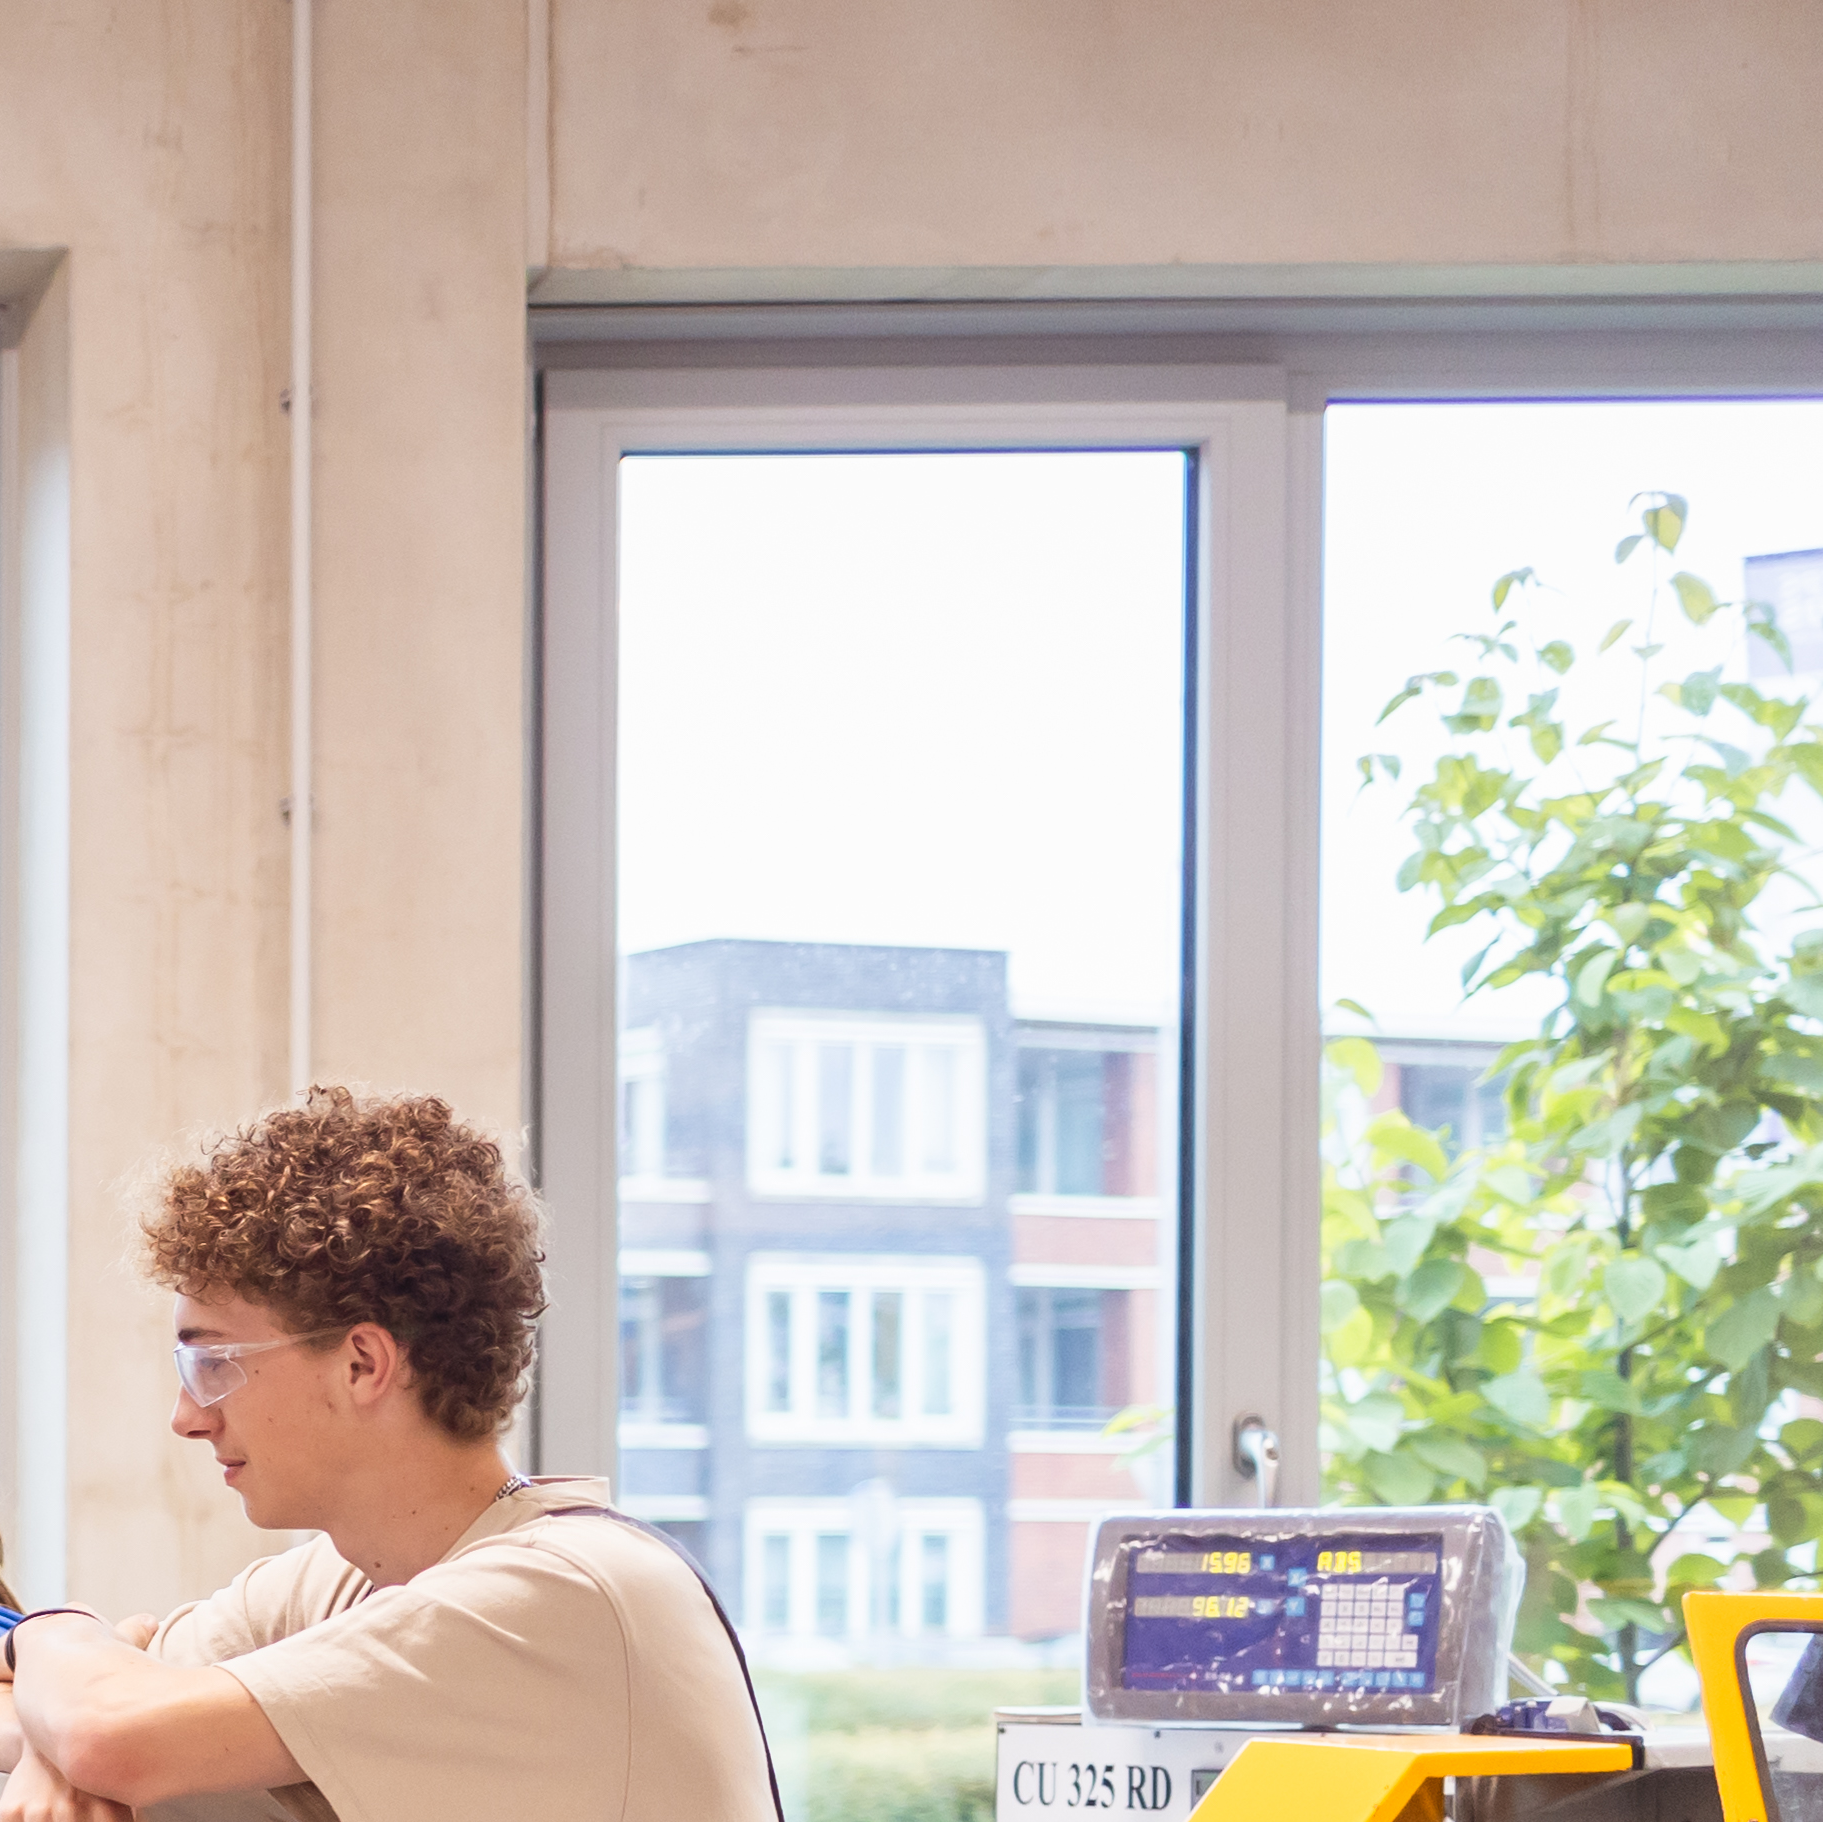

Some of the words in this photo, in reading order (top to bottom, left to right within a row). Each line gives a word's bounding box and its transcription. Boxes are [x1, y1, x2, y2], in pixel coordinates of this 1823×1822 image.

[1013, 1761, 1057, 1806] CU
[1067, 1763, 1115, 1808] 325
[1126, 1765, 1172, 1810] RD
